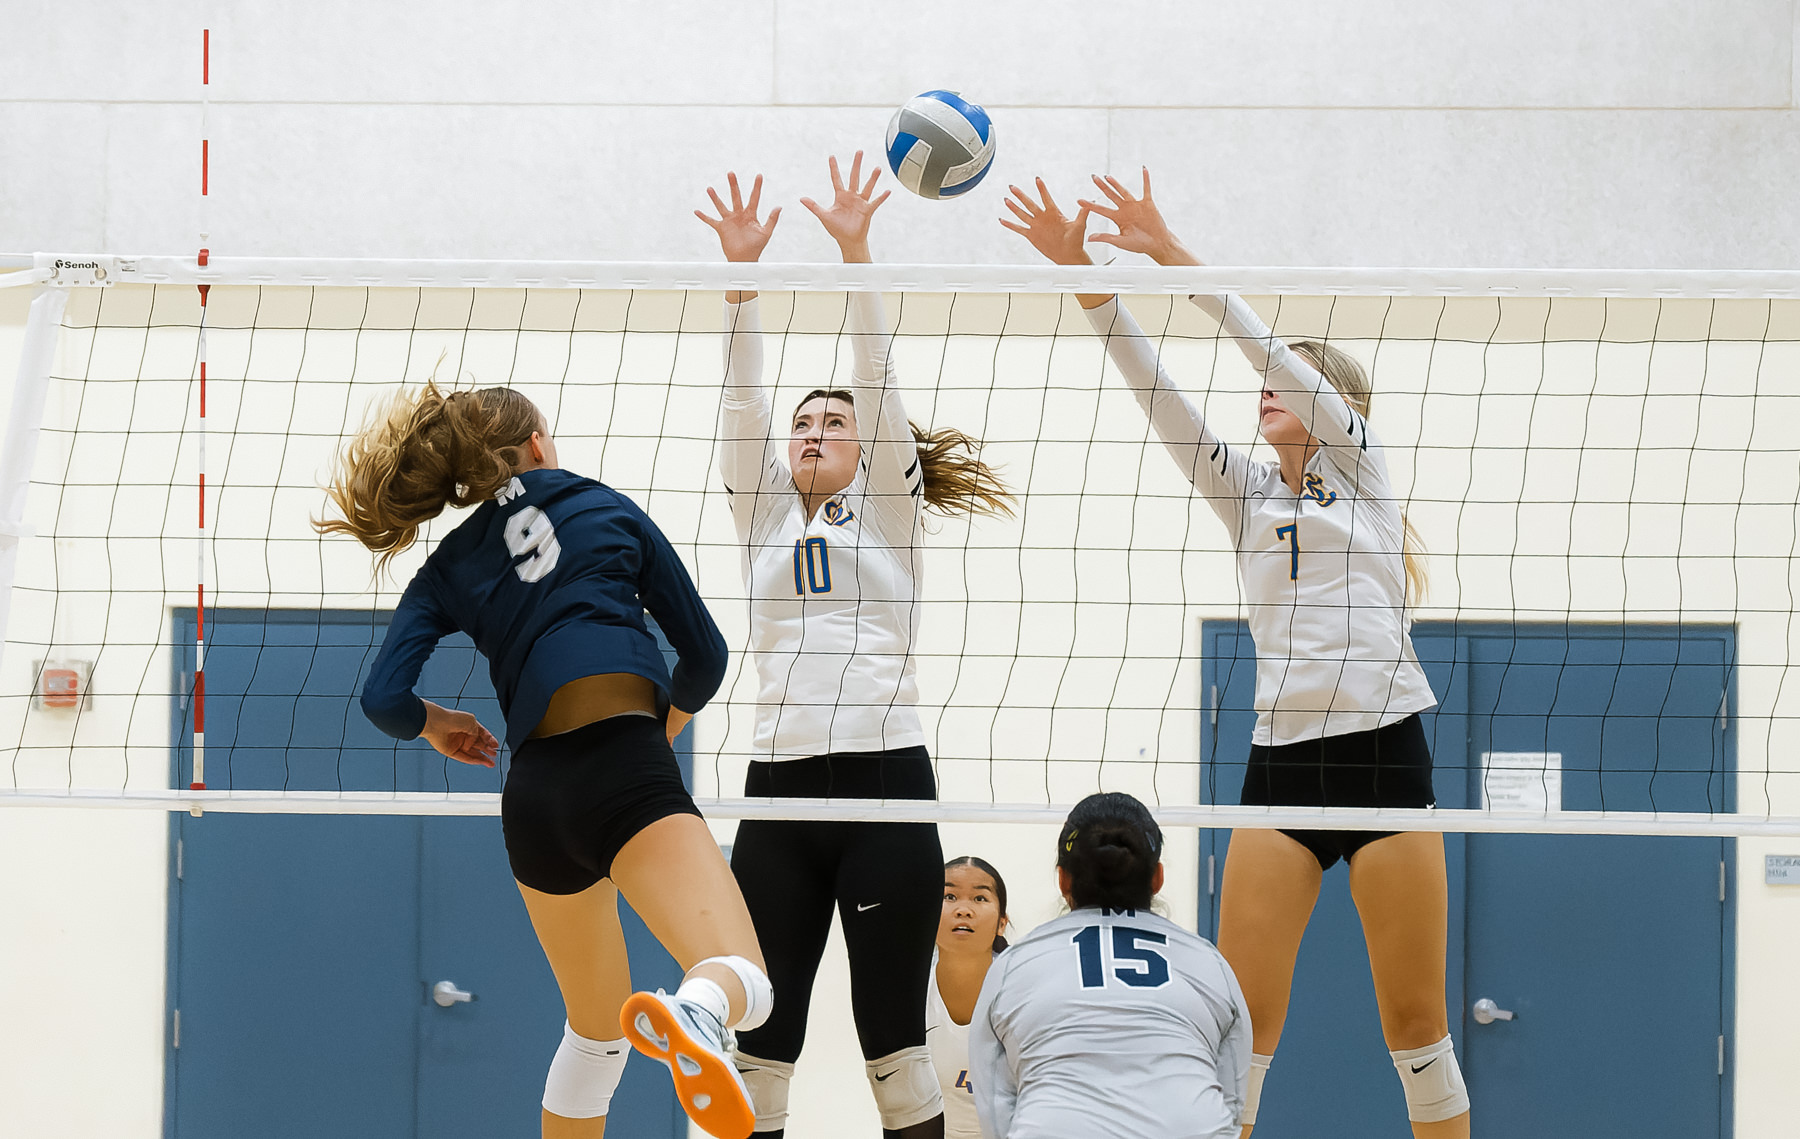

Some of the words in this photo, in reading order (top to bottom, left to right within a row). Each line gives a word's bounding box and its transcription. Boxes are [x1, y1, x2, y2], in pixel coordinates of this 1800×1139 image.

[64, 261, 99, 269] Senoh
[494, 476, 526, 507] M
[503, 505, 562, 583] 9
[792, 536, 832, 595] 10
[1275, 523, 1300, 581] 7
[1070, 924, 1172, 990] 15
[954, 1069, 974, 1095] 4
